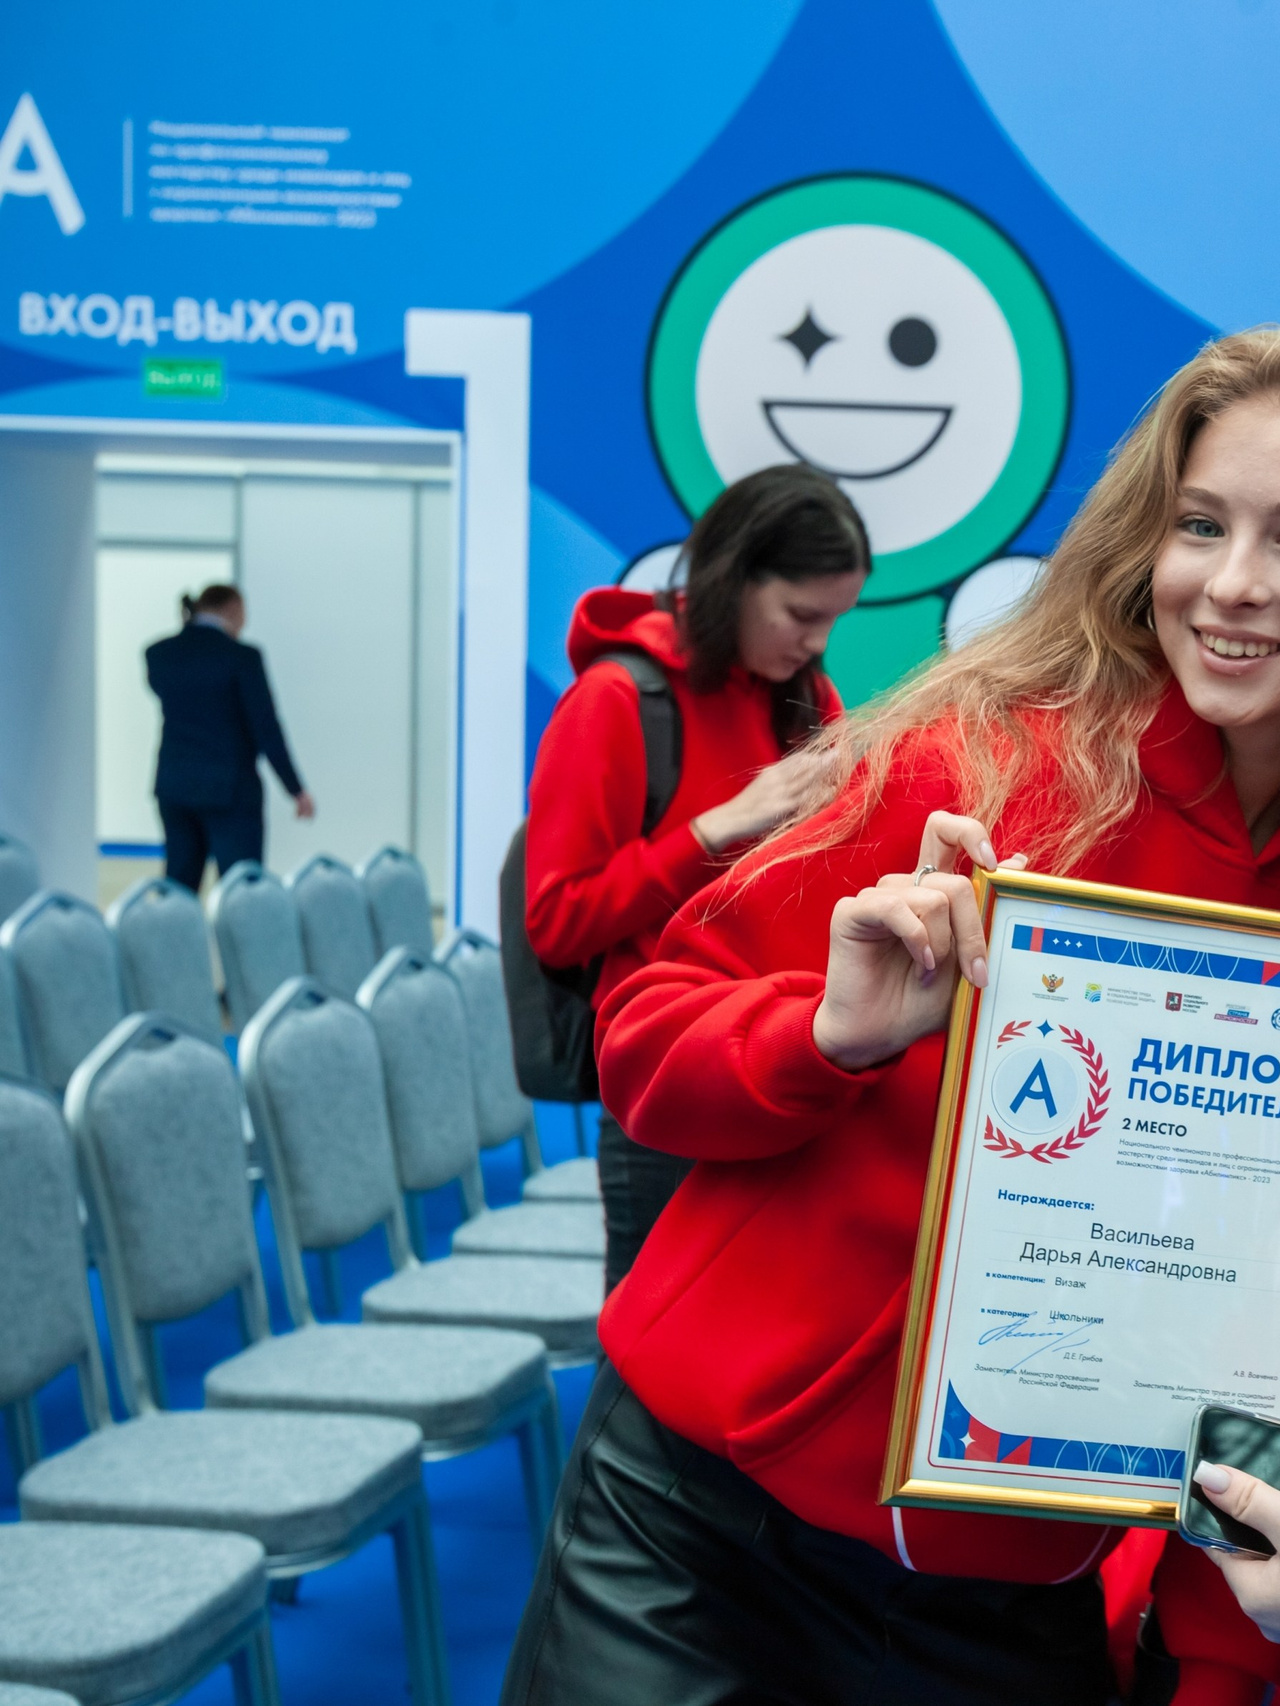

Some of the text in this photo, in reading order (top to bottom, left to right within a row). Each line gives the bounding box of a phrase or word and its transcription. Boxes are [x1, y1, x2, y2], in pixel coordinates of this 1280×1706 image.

[18, 291, 357, 354] ВХОД-ВЫХОД
[1009, 1058, 1058, 1119] А
[1122, 1117, 1188, 1137] 2 МЕСТО
[1119, 1138, 1171, 1152] Национального
[1172, 1146, 1211, 1157] чемпионата
[1117, 1150, 1155, 1160] мастерству
[1156, 1155, 1176, 1163] среди
[1177, 1157, 1212, 1167] инвалидов
[1116, 1160, 1168, 1171] возможностями
[1169, 1166, 1199, 1175] здоровья
[1252, 1175, 1271, 1184] 2023
[997, 1189, 1095, 1211] Награждается:
[1090, 1222, 1195, 1251] Васильева
[1019, 1241, 1237, 1284] Дарья Александровна
[992, 1272, 1046, 1284] компетенции:
[1054, 1276, 1087, 1289] Визаж
[987, 1308, 1030, 1319] категории:
[1049, 1310, 1104, 1325] Школьники
[1078, 1353, 1103, 1363] Грибов
[974, 1363, 1100, 1383] Заместитель Министра просвещения
[1018, 1376, 1099, 1392] Российской Федерации
[1133, 1380, 1175, 1391] Заместитель
[1176, 1385, 1211, 1395] Министра
[1211, 1389, 1231, 1398] труда
[1237, 1391, 1276, 1401] социальной
[1171, 1393, 1196, 1402] защиты
[1236, 1399, 1275, 1409] Федерации
